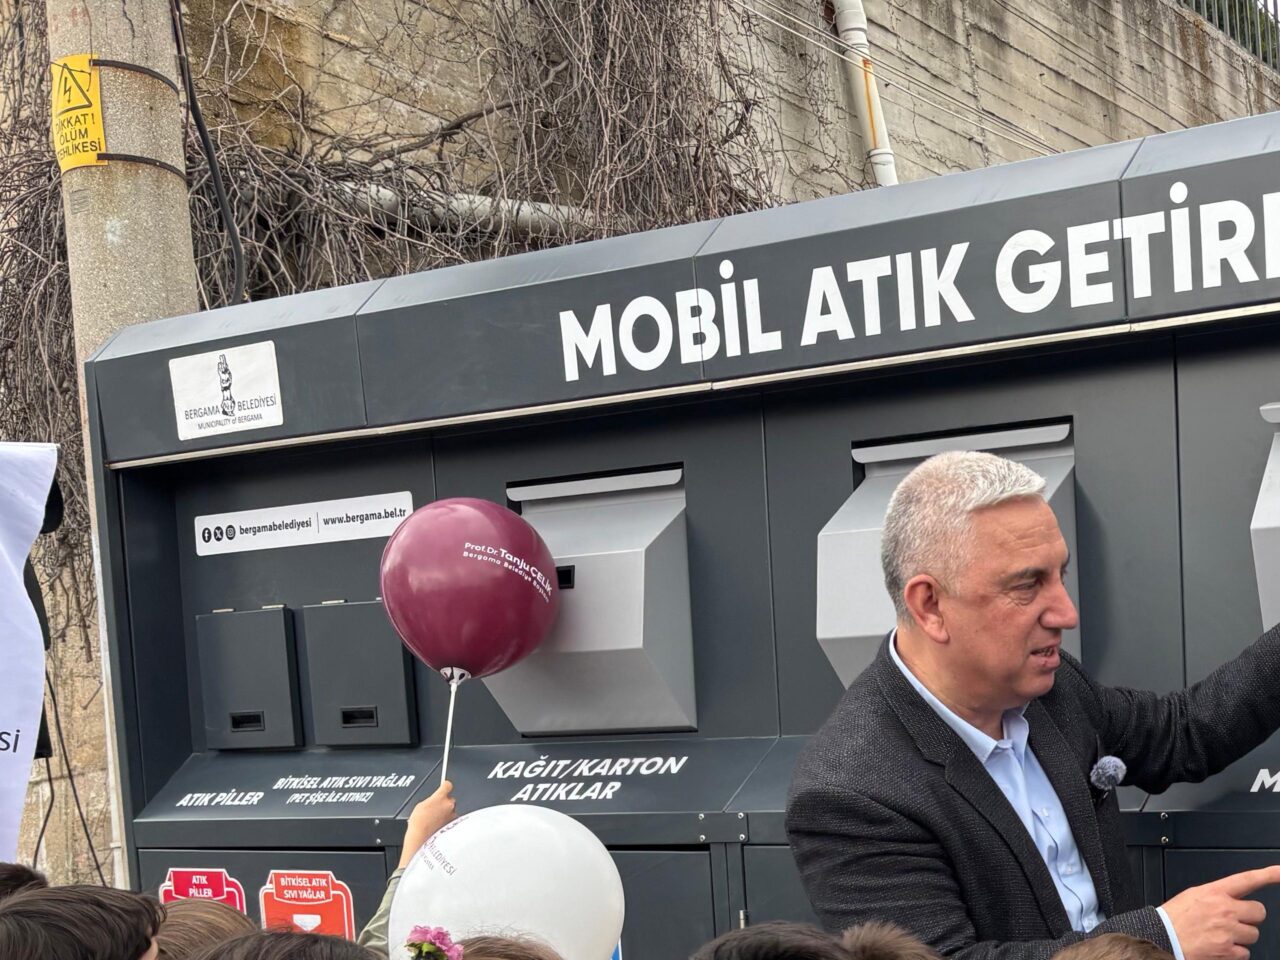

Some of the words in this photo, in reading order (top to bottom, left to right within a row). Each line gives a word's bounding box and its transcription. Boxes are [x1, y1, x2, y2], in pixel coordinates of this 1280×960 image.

[558, 259, 783, 382] MOBİL
[800, 242, 976, 346] ATIK
[184, 405, 221, 420] BERGAMA
[237, 393, 277, 411] BELEDİYESİ
[197, 418, 231, 430] MUNICIPALITY
[238, 413, 263, 424] BERGAMA
[239, 517, 312, 536] bergamabelediyesi
[323, 508, 407, 526] www.bergama.bel.tr
[463, 551, 501, 565] Bergama
[499, 548, 531, 572] Tanju
[487, 755, 689, 779] KAĞIT/KARTON
[272, 774, 320, 790] BİTKİSEL
[319, 776, 351, 788] ATIK
[346, 776, 372, 788] SIVI
[367, 772, 416, 788] YAĞLAR
[176, 792, 214, 807] ATIK
[212, 788, 265, 806] PİLLER
[510, 781, 622, 802] ATIKLAR
[191, 875, 208, 885] ATIK
[280, 876, 311, 887] BİTKİSEL
[311, 878, 328, 887] ATIK
[188, 887, 213, 898] PİLLER
[284, 890, 298, 899] SIVI
[298, 888, 325, 900] YAĞLAR
